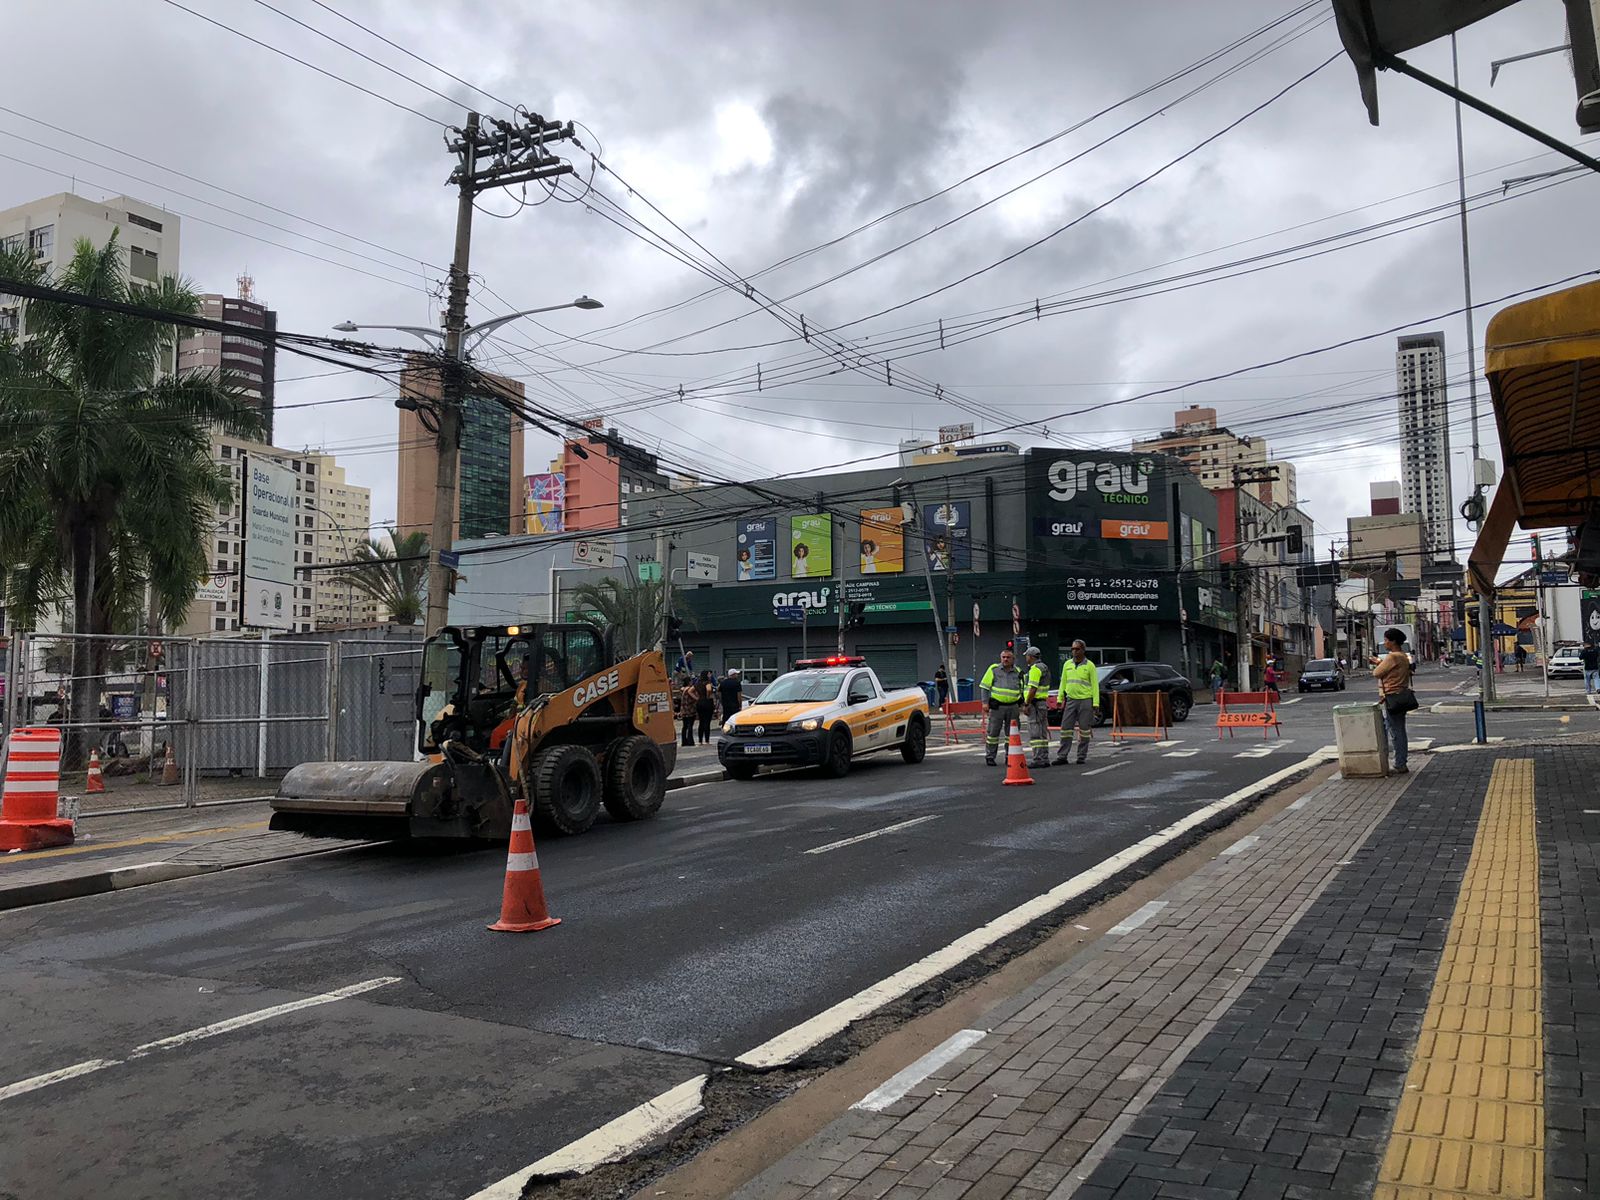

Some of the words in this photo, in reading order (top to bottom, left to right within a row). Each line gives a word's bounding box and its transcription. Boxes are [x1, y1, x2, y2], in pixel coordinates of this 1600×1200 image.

[253, 468, 270, 485] Base
[1048, 460, 1149, 502] grau
[252, 505, 269, 518] Guarda
[871, 512, 891, 524] grau
[746, 522, 765, 532] grau
[802, 519, 822, 529] grau
[1051, 522, 1081, 536] grau
[1120, 524, 1149, 537] grau
[1089, 578, 1101, 588] 19
[1066, 603, 1158, 612] www.grautecnico.com.br
[573, 669, 619, 708] CASE
